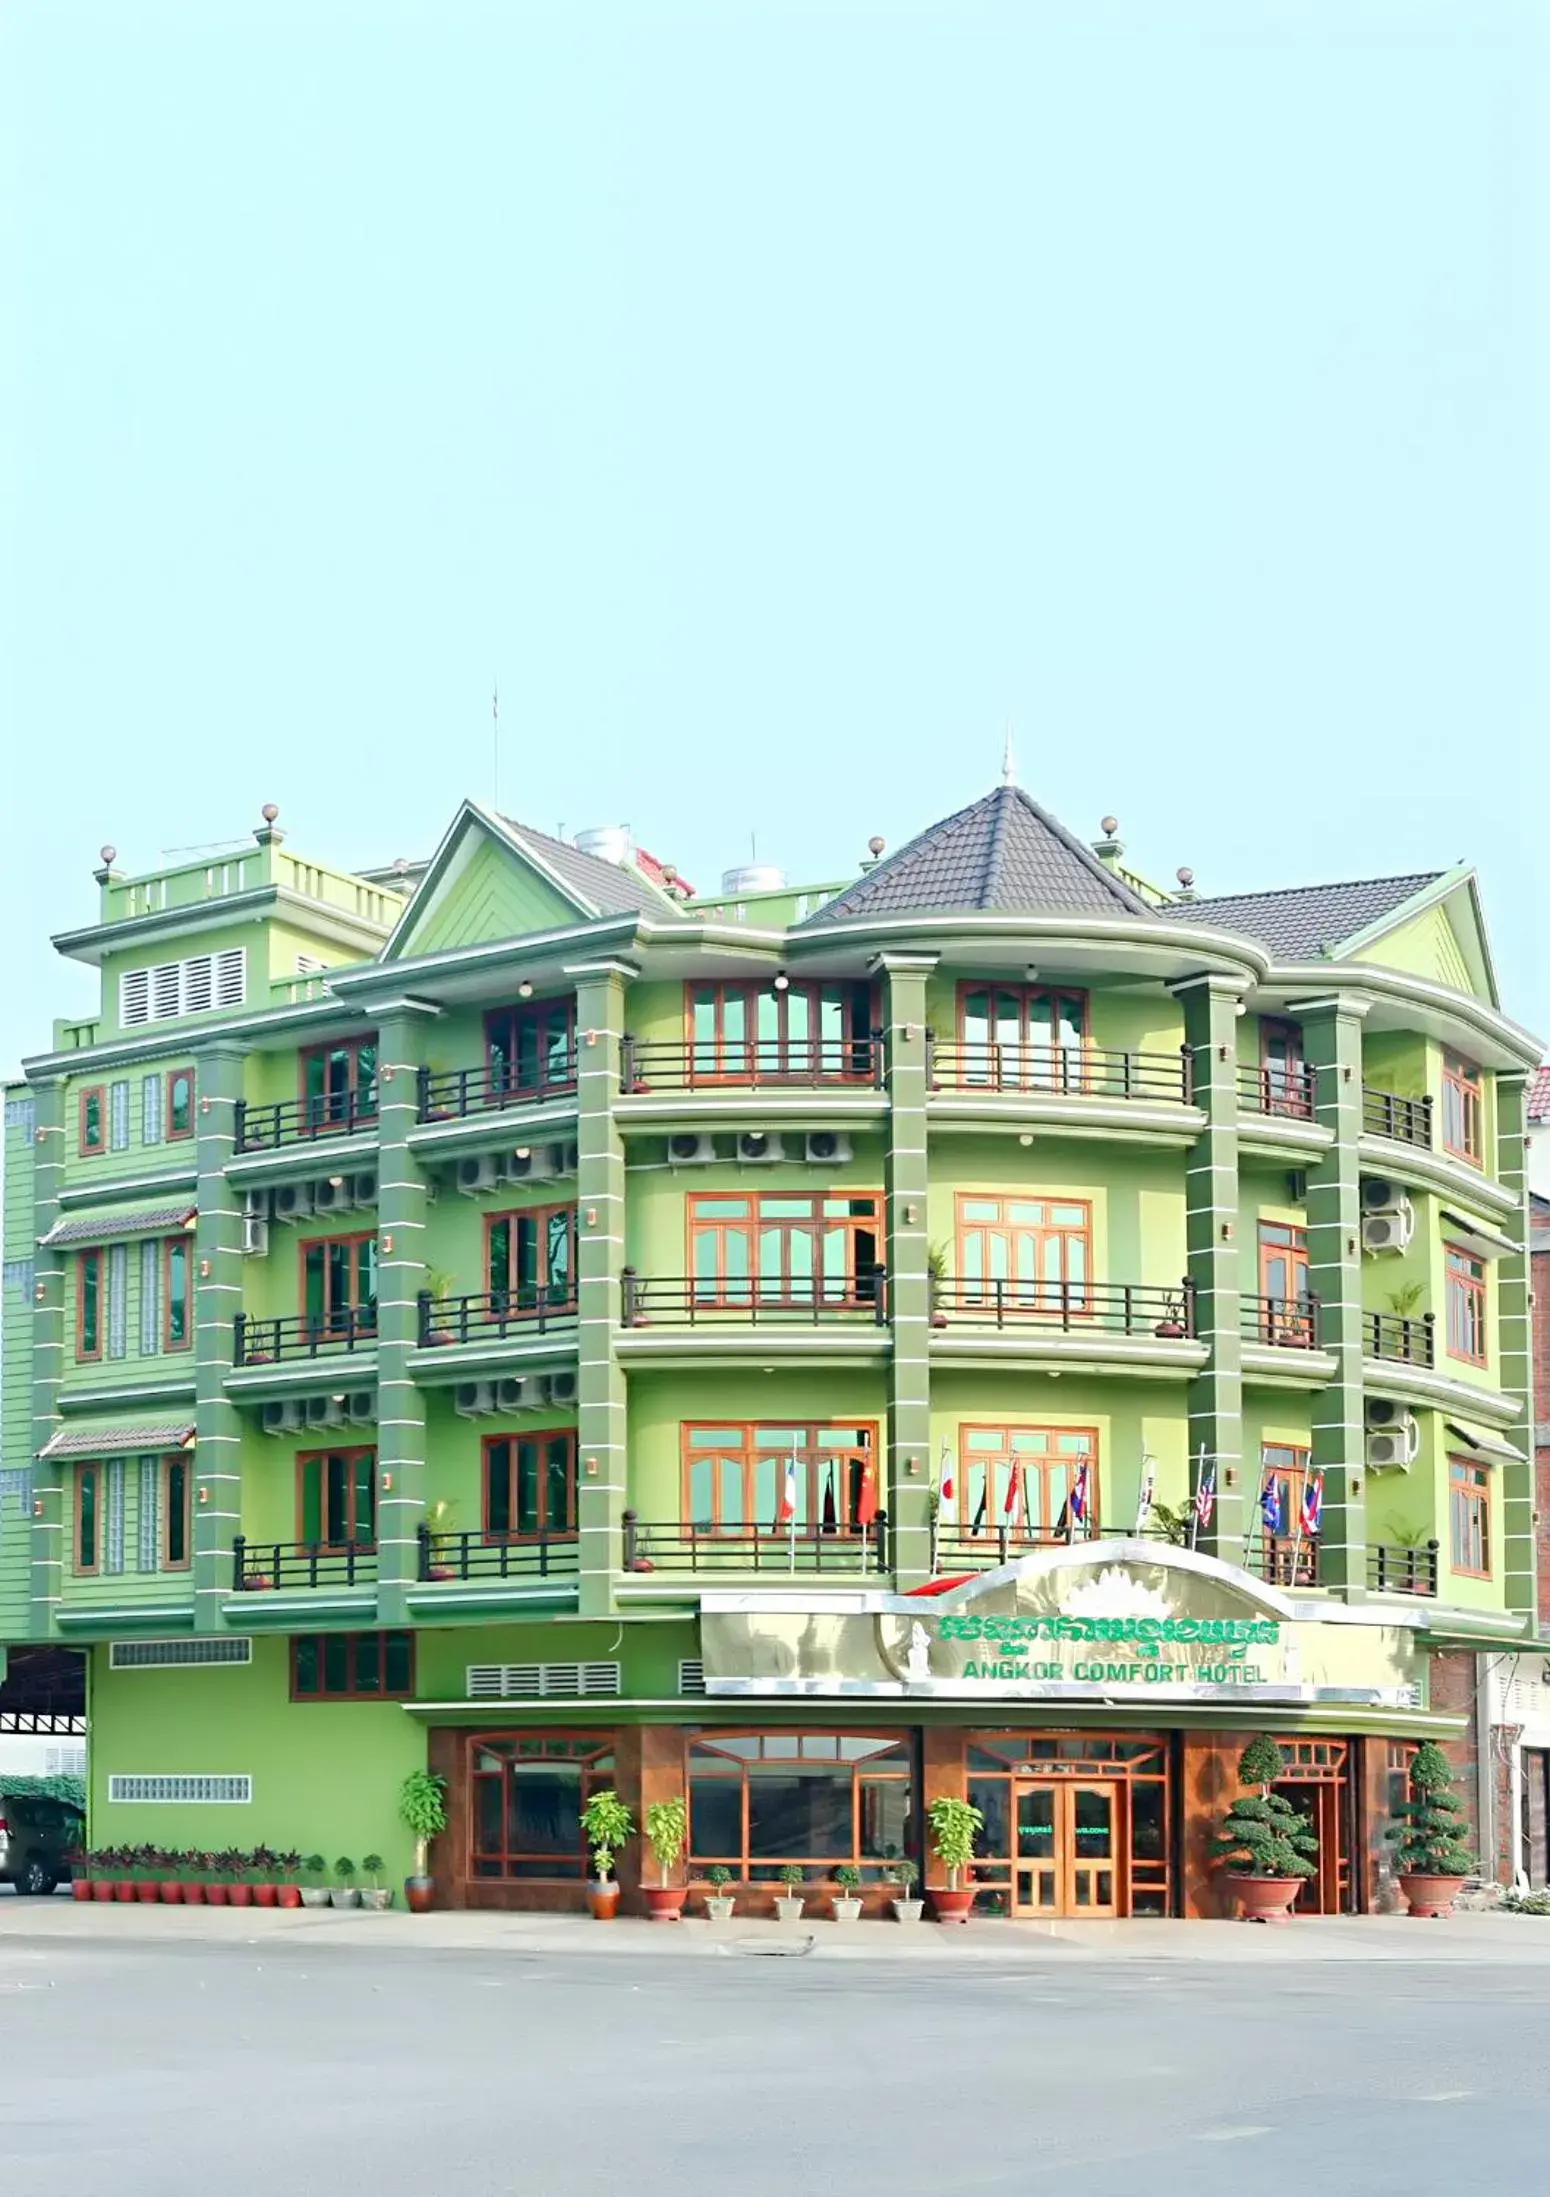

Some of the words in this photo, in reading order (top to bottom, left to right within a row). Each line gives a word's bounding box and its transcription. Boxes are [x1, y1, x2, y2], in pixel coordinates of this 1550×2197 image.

[963, 1661, 1064, 1680] ANGKOR
[1074, 1662, 1189, 1682] COMFORT
[1195, 1664, 1268, 1684] HOTEL
